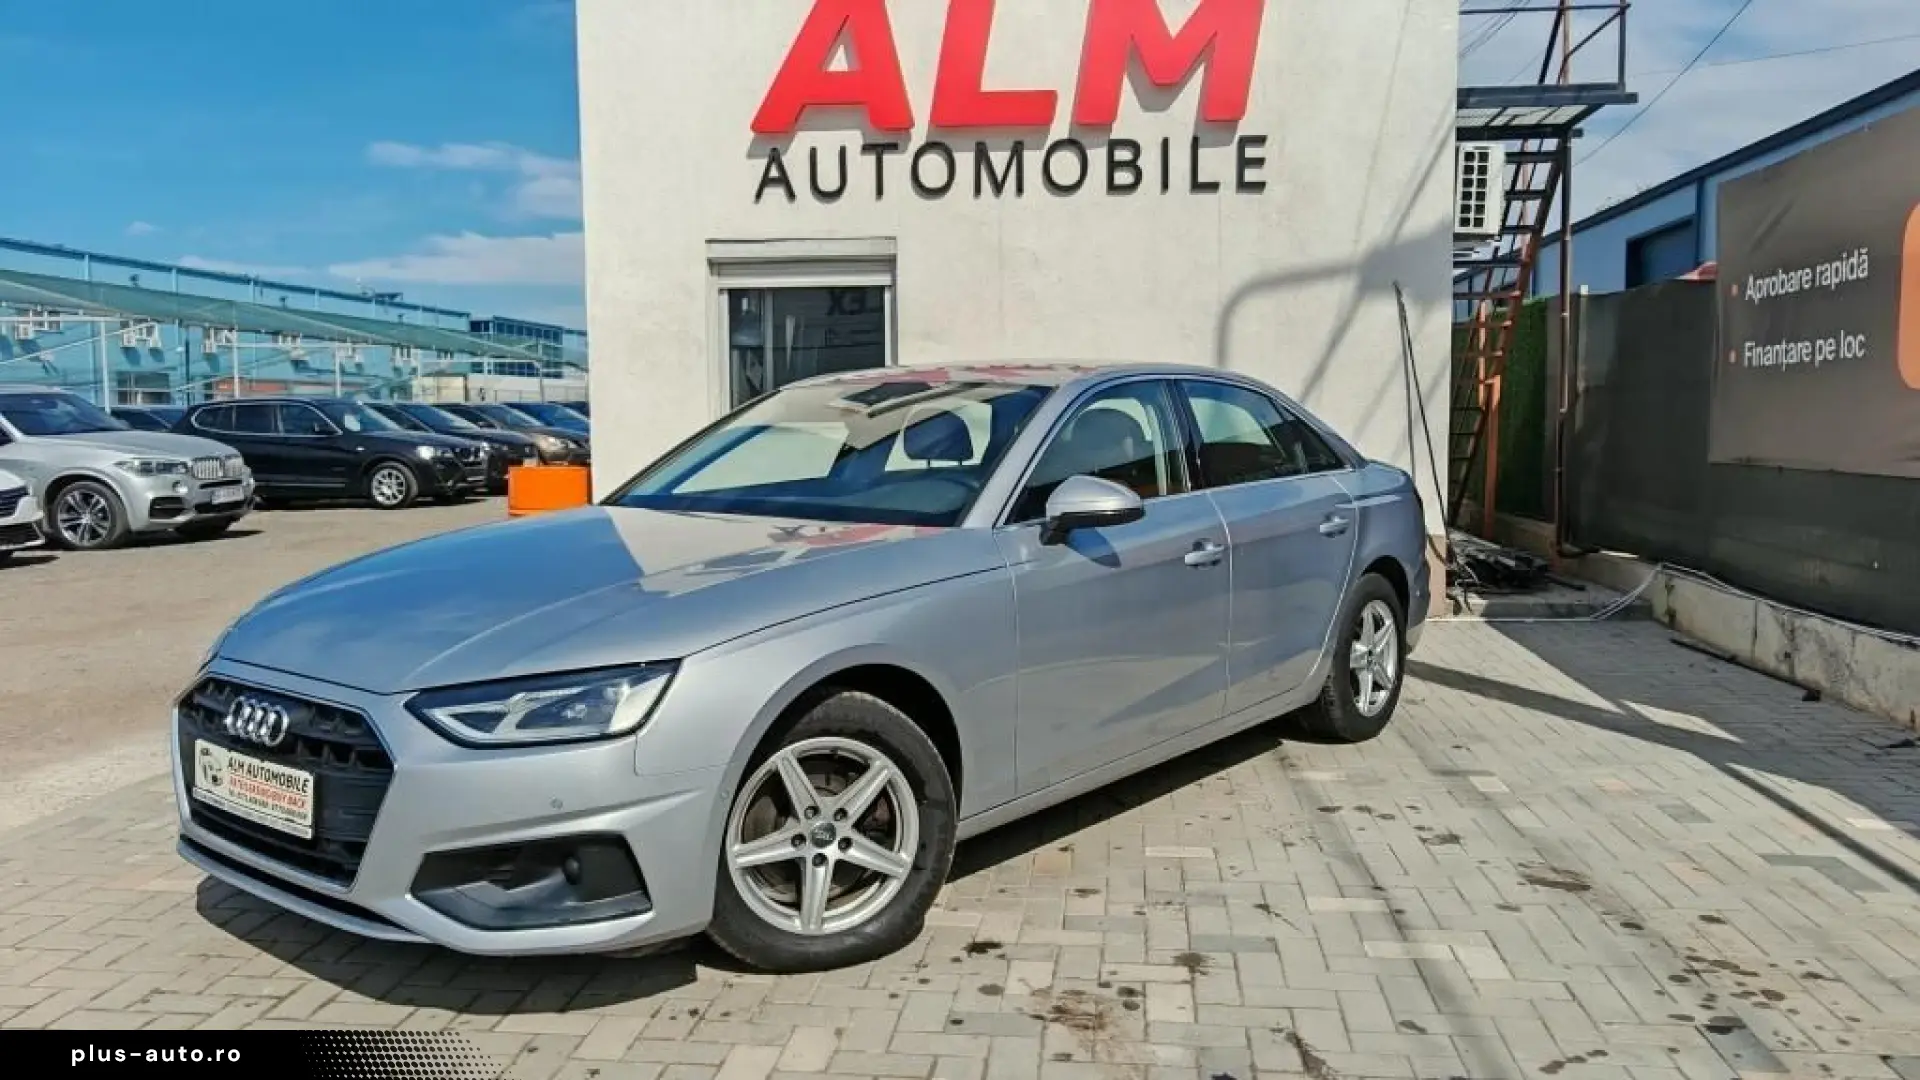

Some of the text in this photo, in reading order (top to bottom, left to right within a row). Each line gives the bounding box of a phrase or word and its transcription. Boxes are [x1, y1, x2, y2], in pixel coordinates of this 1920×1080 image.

[751, 0, 1265, 132] ALM
[754, 135, 1268, 203] AUTOMOBILE
[1745, 248, 1868, 305] Aprobare rapidă
[1815, 336, 1836, 368] pe
[1840, 329, 1865, 359] loc
[246, 762, 309, 794] AUTOMOBILE
